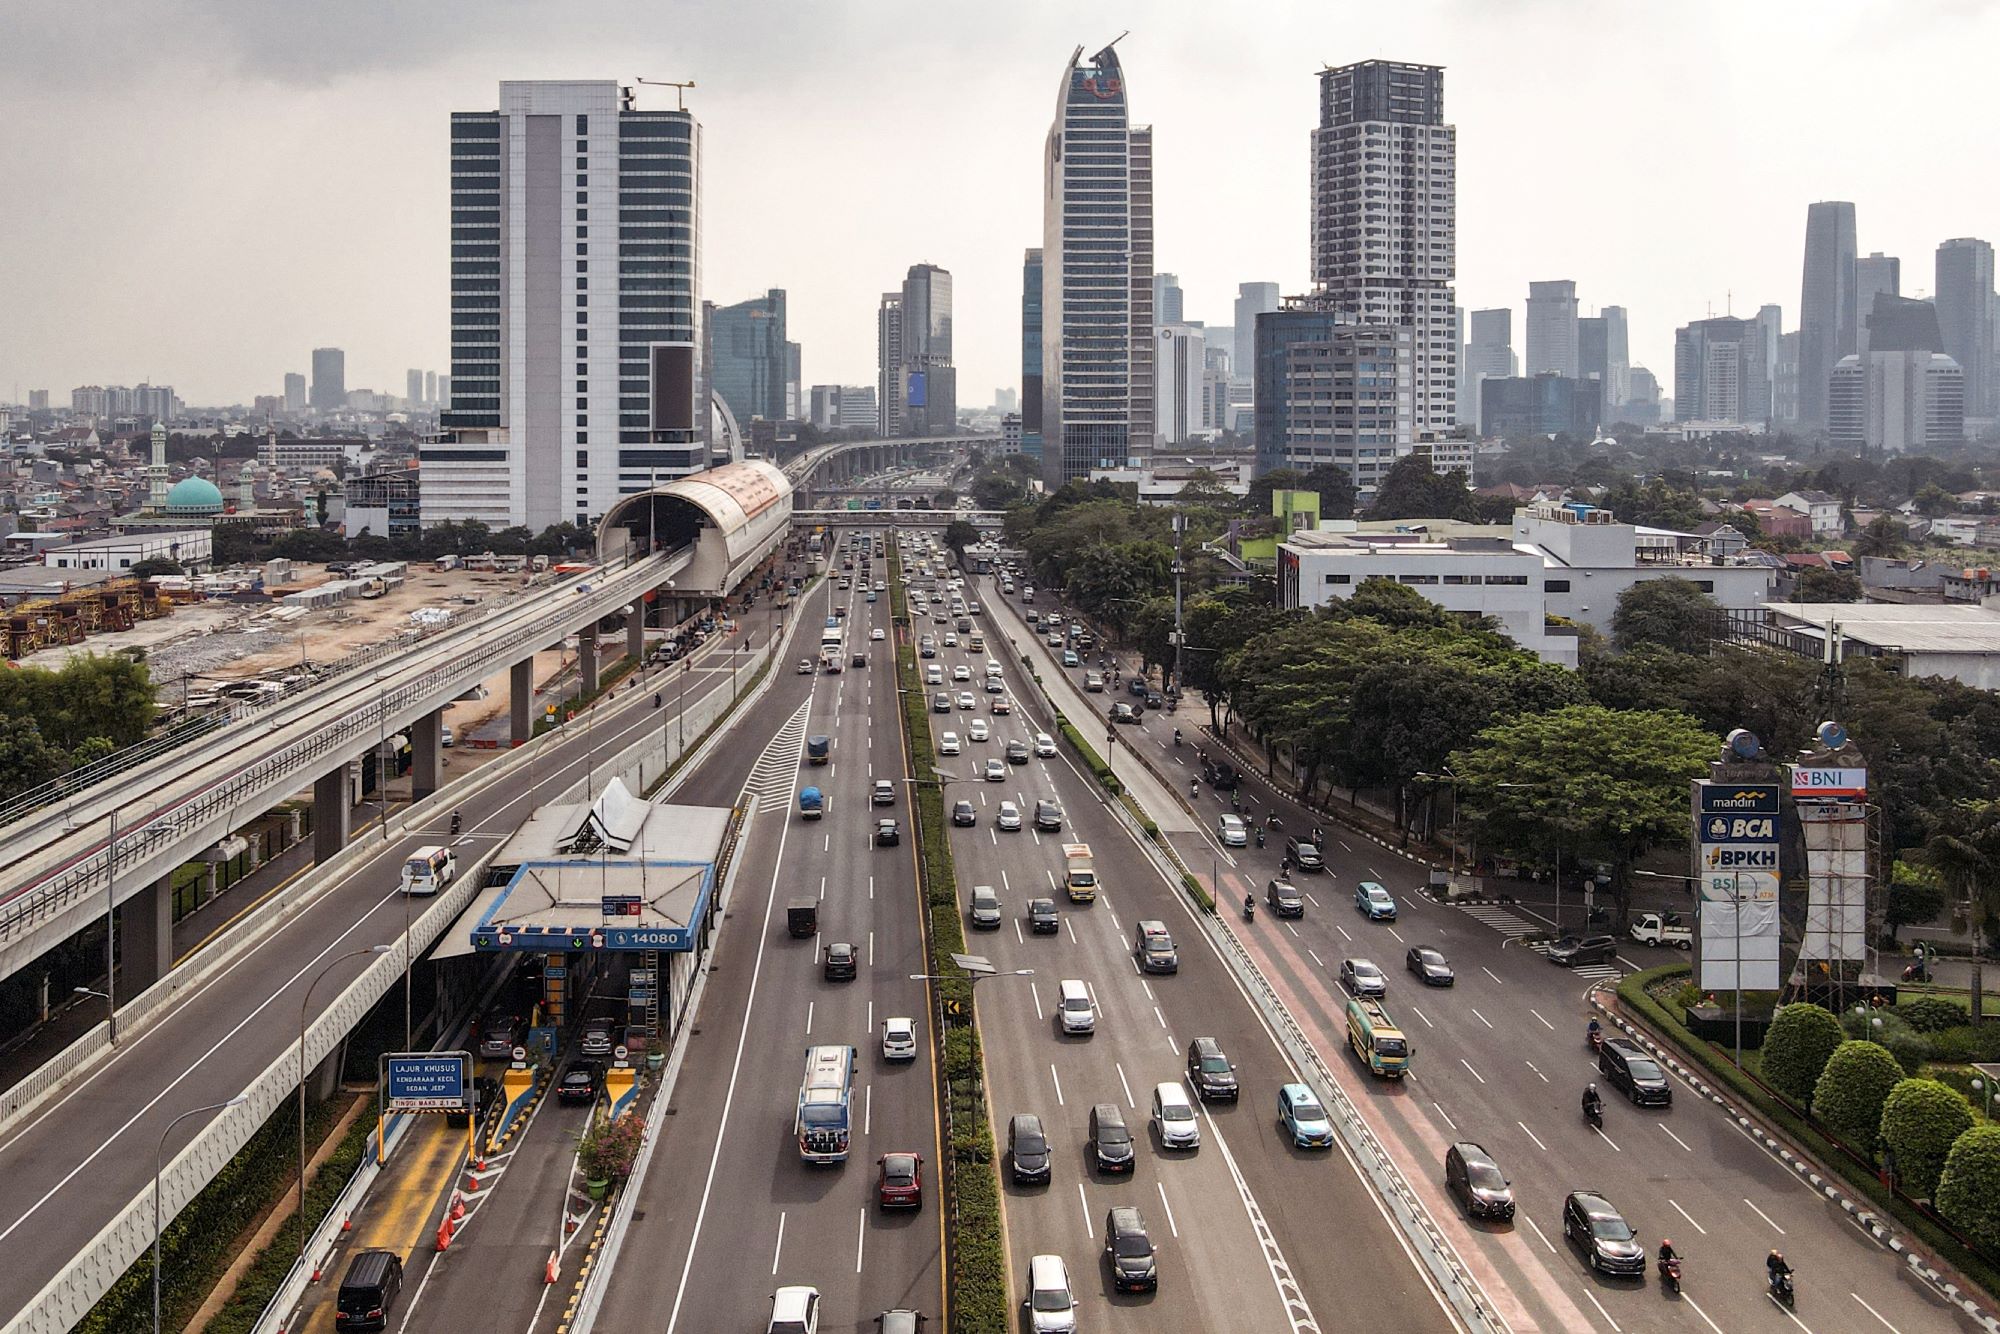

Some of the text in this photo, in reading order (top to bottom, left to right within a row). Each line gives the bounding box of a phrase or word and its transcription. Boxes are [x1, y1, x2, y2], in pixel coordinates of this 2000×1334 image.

[1812, 772, 1842, 785] BNI
[1713, 797, 1756, 808] mandiri
[1731, 819, 1772, 838] BCA
[1720, 850, 1776, 866] BPKH
[1713, 879, 1735, 890] BSI
[631, 934, 678, 944] 14080
